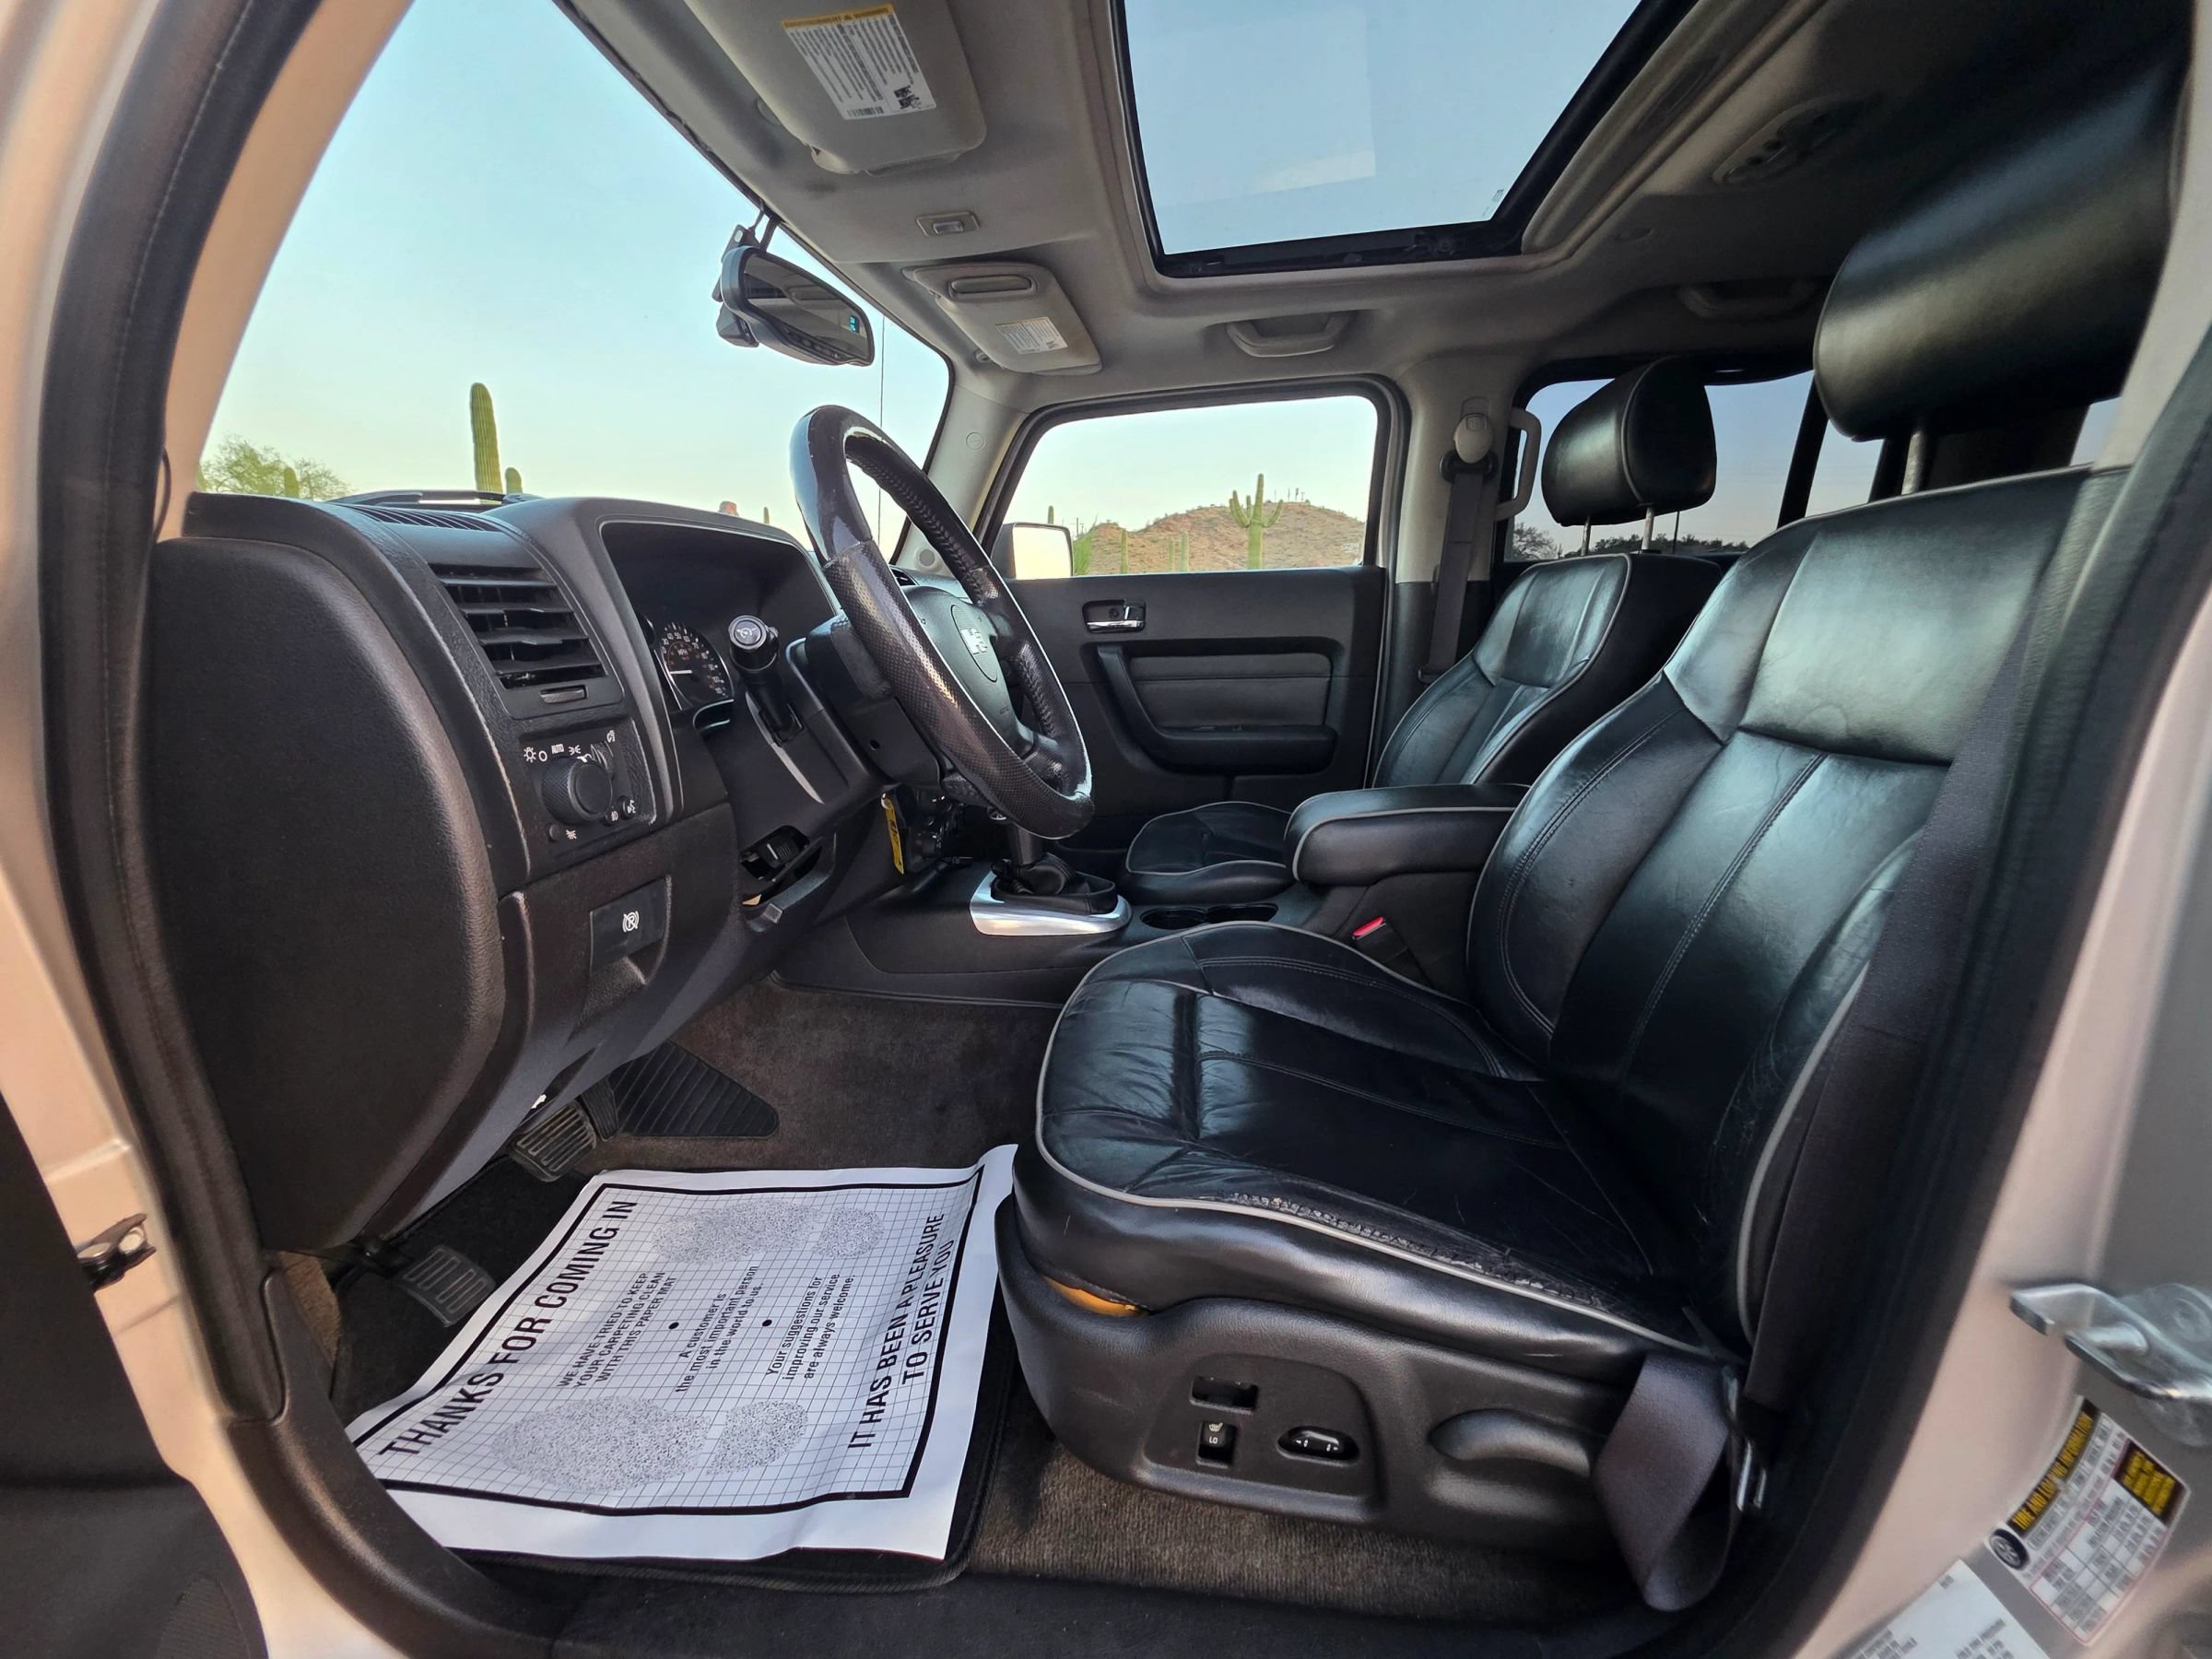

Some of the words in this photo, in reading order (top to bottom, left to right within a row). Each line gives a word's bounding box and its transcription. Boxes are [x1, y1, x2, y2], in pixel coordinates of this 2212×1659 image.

[900, 1213, 945, 1296] PLEASURE
[930, 1240, 954, 1278] YOU
[378, 1372, 504, 1455] THANKS
[488, 1317, 553, 1364] FOR
[535, 1228, 619, 1309] COMING
[602, 1201, 638, 1219] IN
[557, 1371, 579, 1387] WE
[572, 1343, 600, 1368] HAVE
[594, 1312, 622, 1340] TRIED
[617, 1298, 633, 1310] TO
[627, 1273, 649, 1295] KEEP
[573, 1359, 605, 1388] YOUR
[599, 1302, 645, 1357] CARPETING
[639, 1272, 665, 1300] CLEAN
[594, 1355, 624, 1382] WITH
[617, 1330, 641, 1353] THIS
[635, 1297, 664, 1328] PAPER
[657, 1277, 677, 1295] MAT
[675, 1375, 695, 1393] the
[689, 1346, 712, 1371] most
[704, 1297, 740, 1343] important
[735, 1265, 759, 1296] person
[687, 1304, 719, 1348] customer
[713, 1293, 726, 1302] is
[705, 1359, 721, 1370] in
[713, 1339, 732, 1356] the
[726, 1310, 748, 1336] world
[741, 1298, 755, 1308] to
[750, 1283, 764, 1297] us.
[765, 1350, 787, 1375] Your
[782, 1291, 816, 1348] suggestions
[807, 1277, 823, 1288] for
[782, 1326, 818, 1380] improving
[810, 1308, 824, 1324] our
[818, 1274, 841, 1306] service
[804, 1361, 819, 1379] are
[813, 1322, 836, 1358] always
[830, 1274, 855, 1320] welcome.
[877, 1313, 909, 1371] BEEN
[911, 1277, 944, 1345] SERVE
[859, 1375, 892, 1425] HAS
[902, 1351, 928, 1385] TO
[848, 1431, 876, 1449] IT
